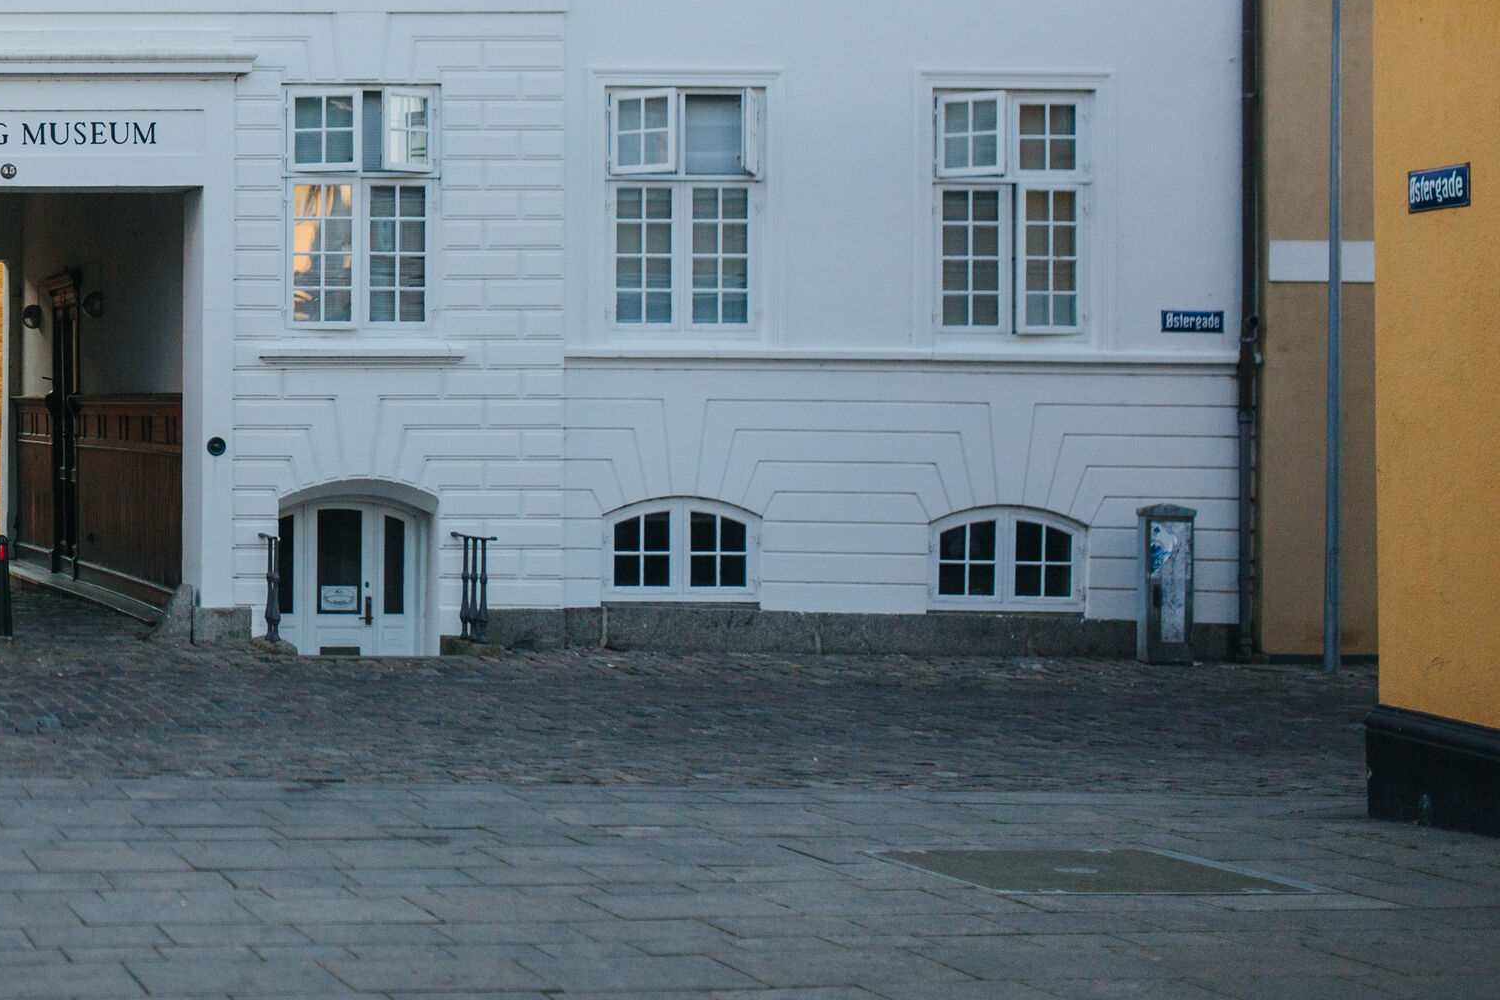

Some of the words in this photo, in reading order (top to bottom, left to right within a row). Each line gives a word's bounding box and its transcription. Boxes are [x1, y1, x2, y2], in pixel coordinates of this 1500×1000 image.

[21, 121, 157, 145] MUSEUM
[1409, 170, 1463, 203] Østergade
[1166, 312, 1220, 330] Østergade
